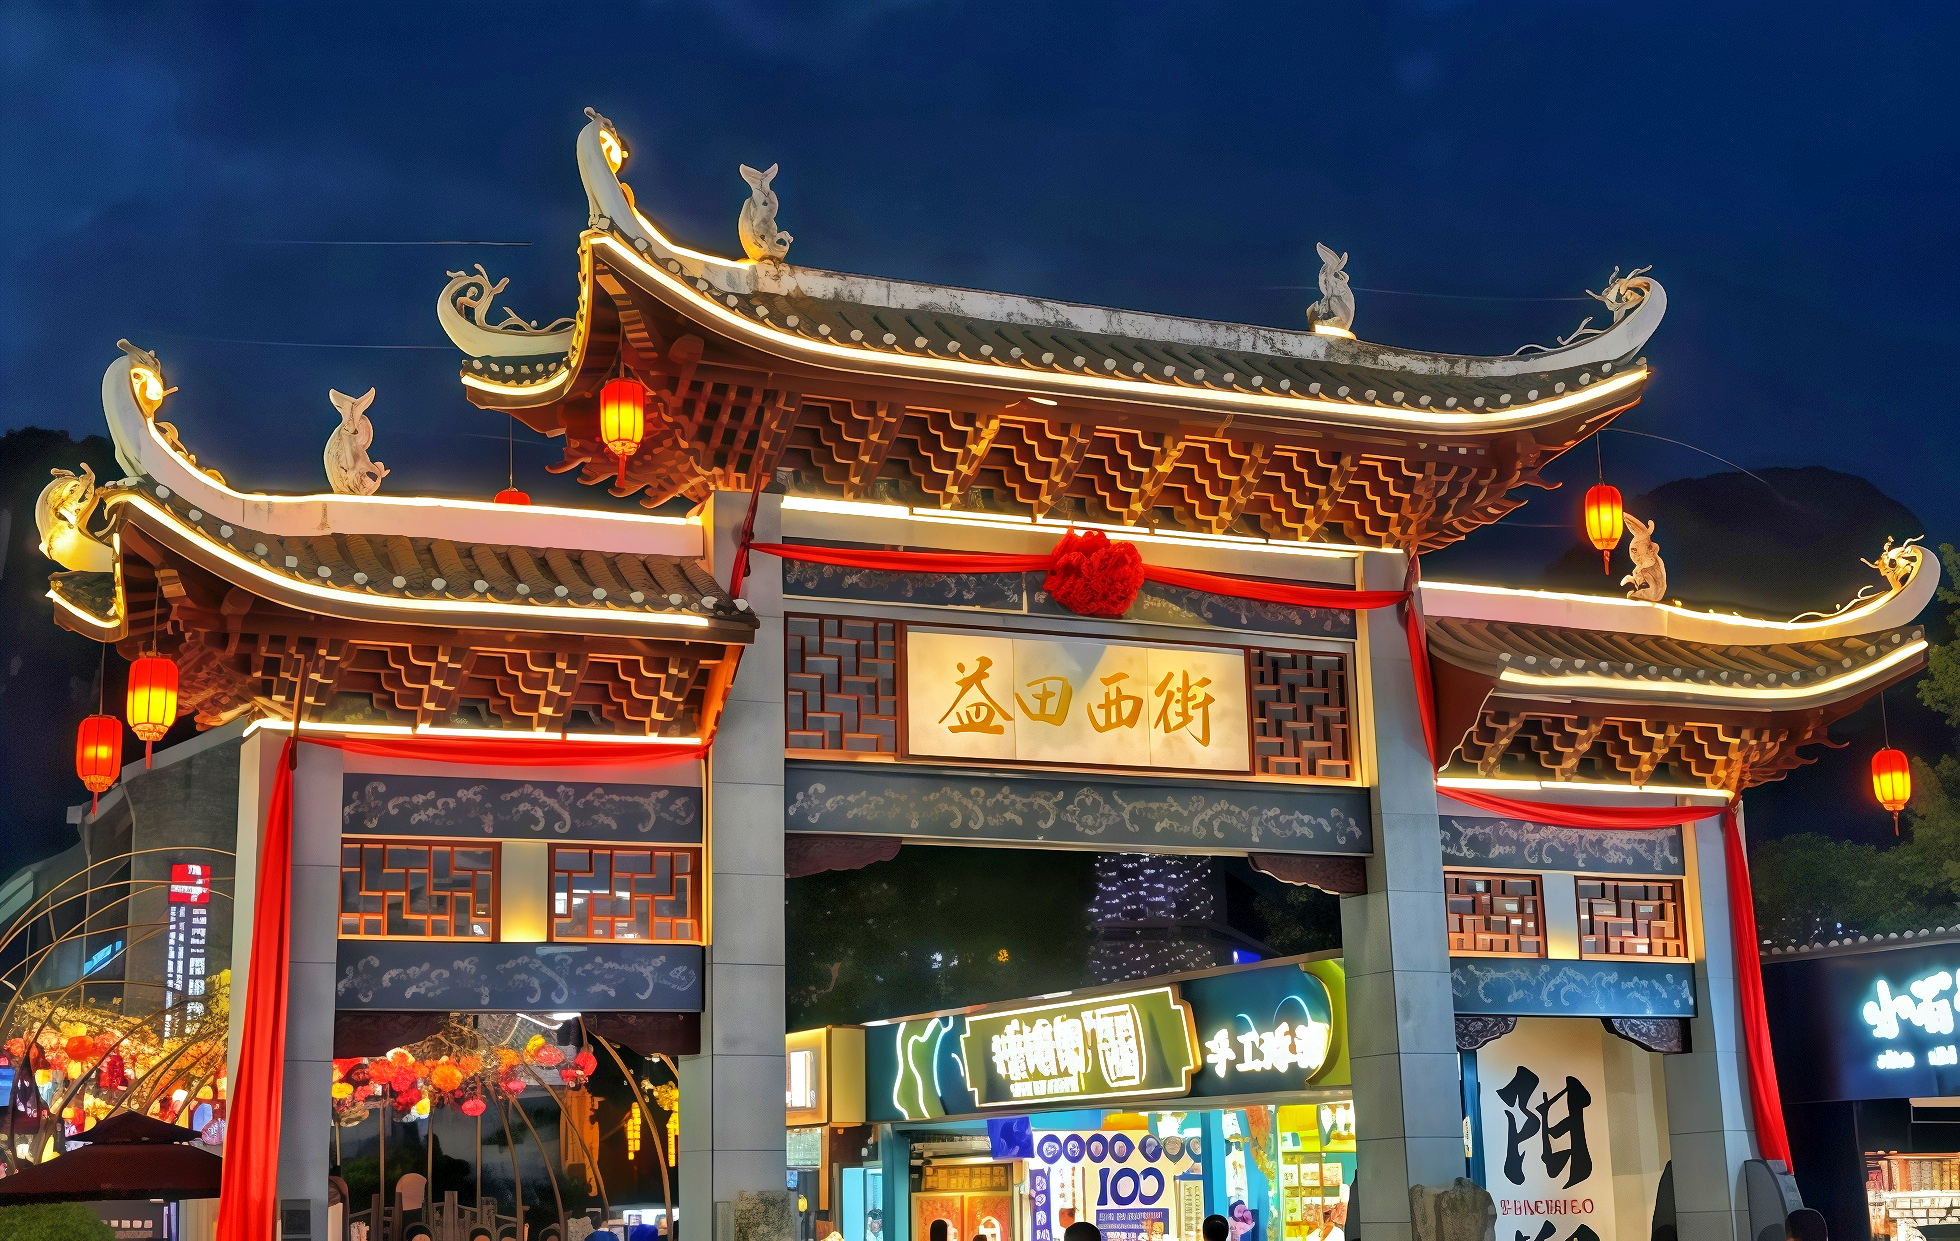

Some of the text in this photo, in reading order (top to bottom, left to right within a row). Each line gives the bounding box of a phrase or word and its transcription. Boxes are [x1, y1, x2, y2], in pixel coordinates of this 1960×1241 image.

[938, 655, 1216, 748] 益田西街
[1096, 1167, 1165, 1207] 100
